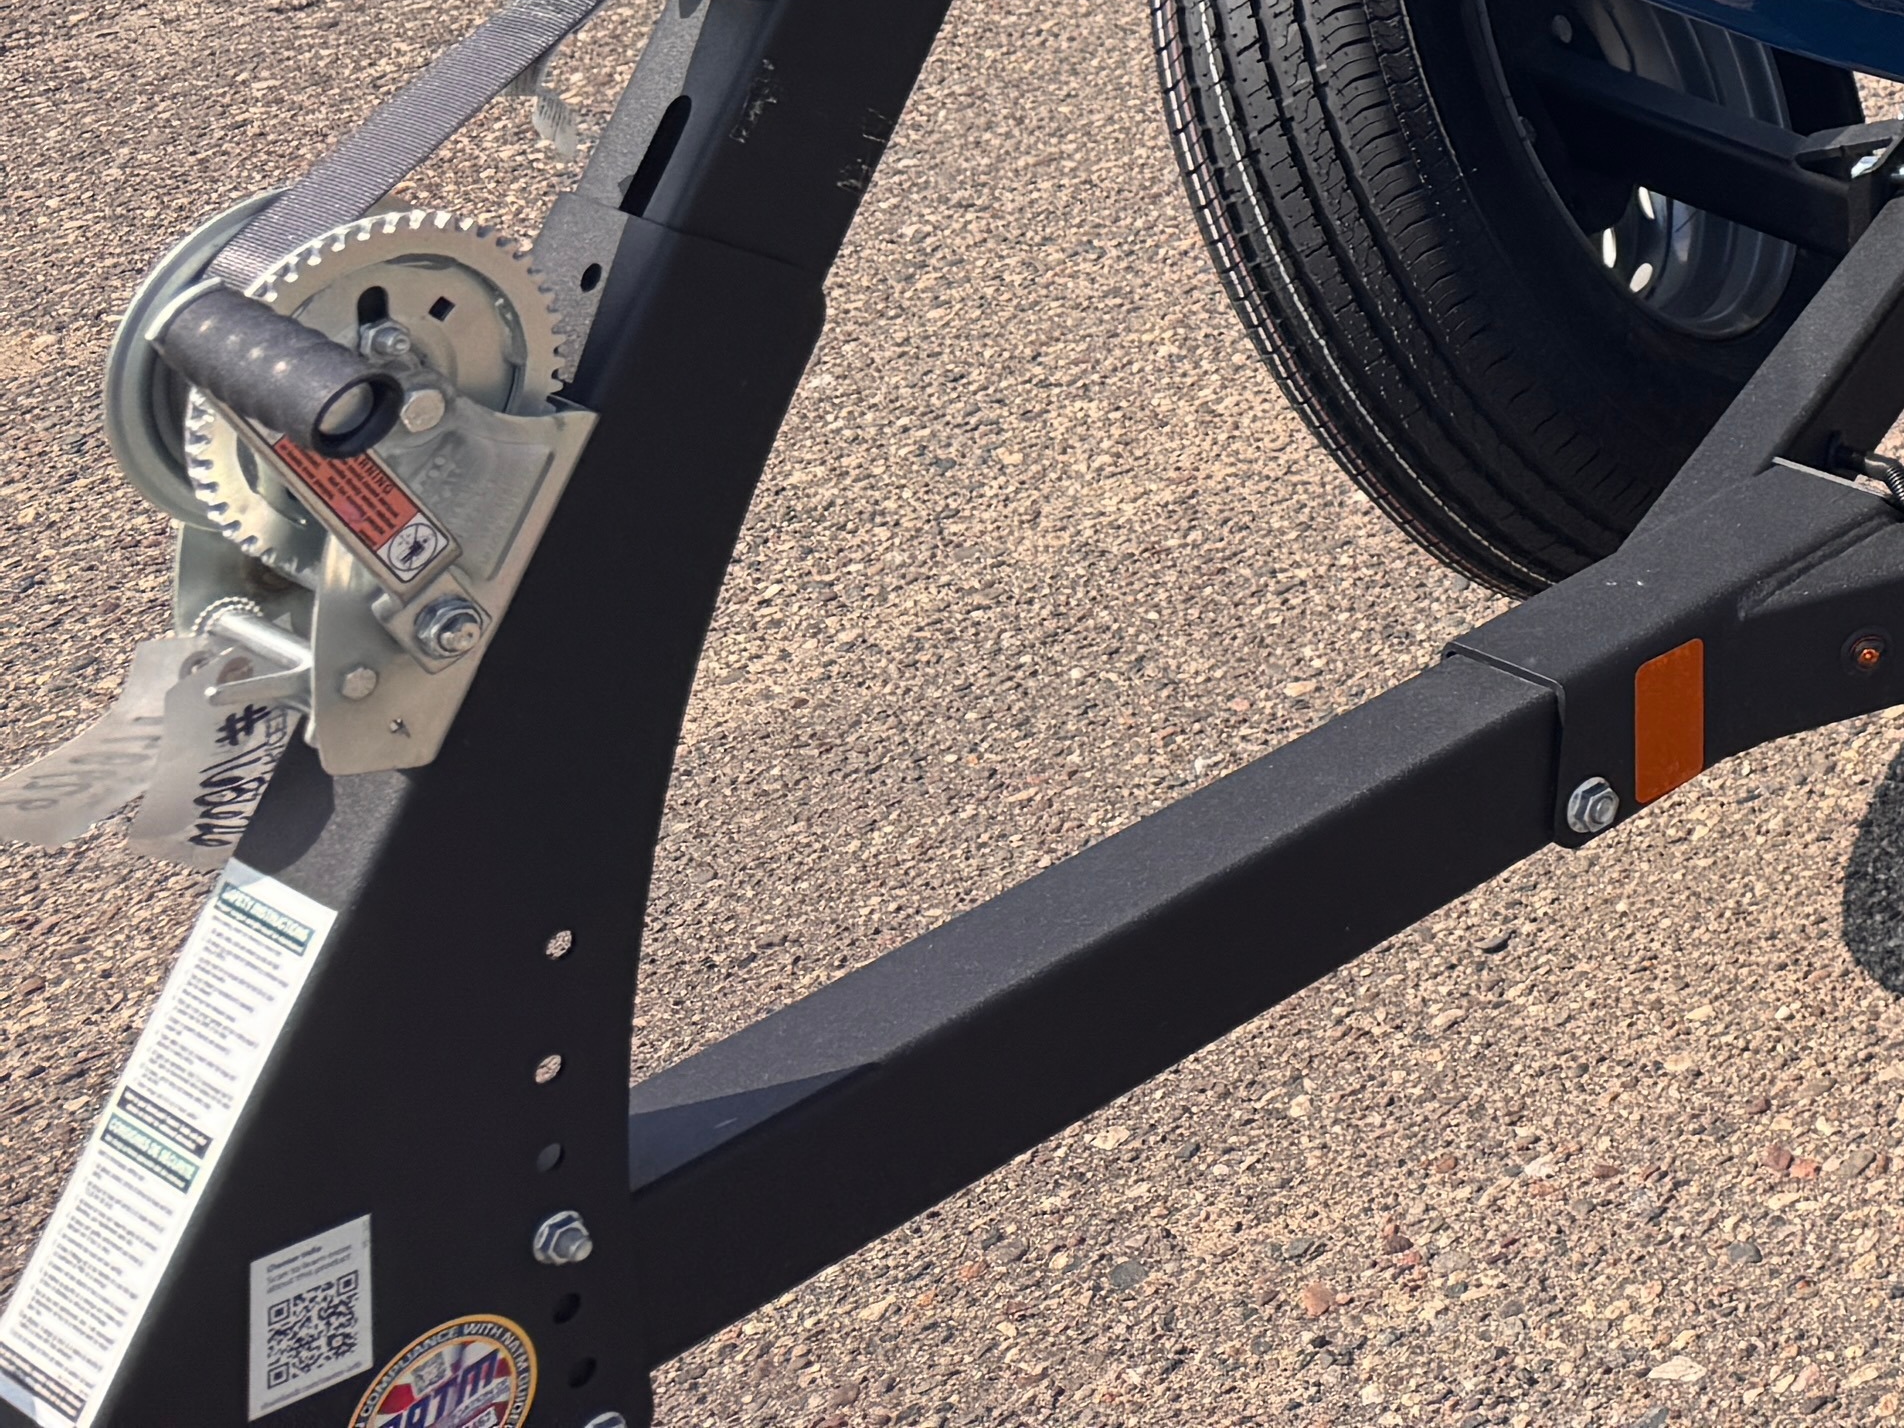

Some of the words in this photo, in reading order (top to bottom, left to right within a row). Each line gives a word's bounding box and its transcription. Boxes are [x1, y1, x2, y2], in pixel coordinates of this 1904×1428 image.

[353, 455, 394, 494] RNING
[463, 1322, 502, 1339] WITH
[360, 1326, 459, 1417] COMPLIANCE
[502, 1332, 529, 1372] NATM
[507, 1373, 531, 1428] GUIDE
